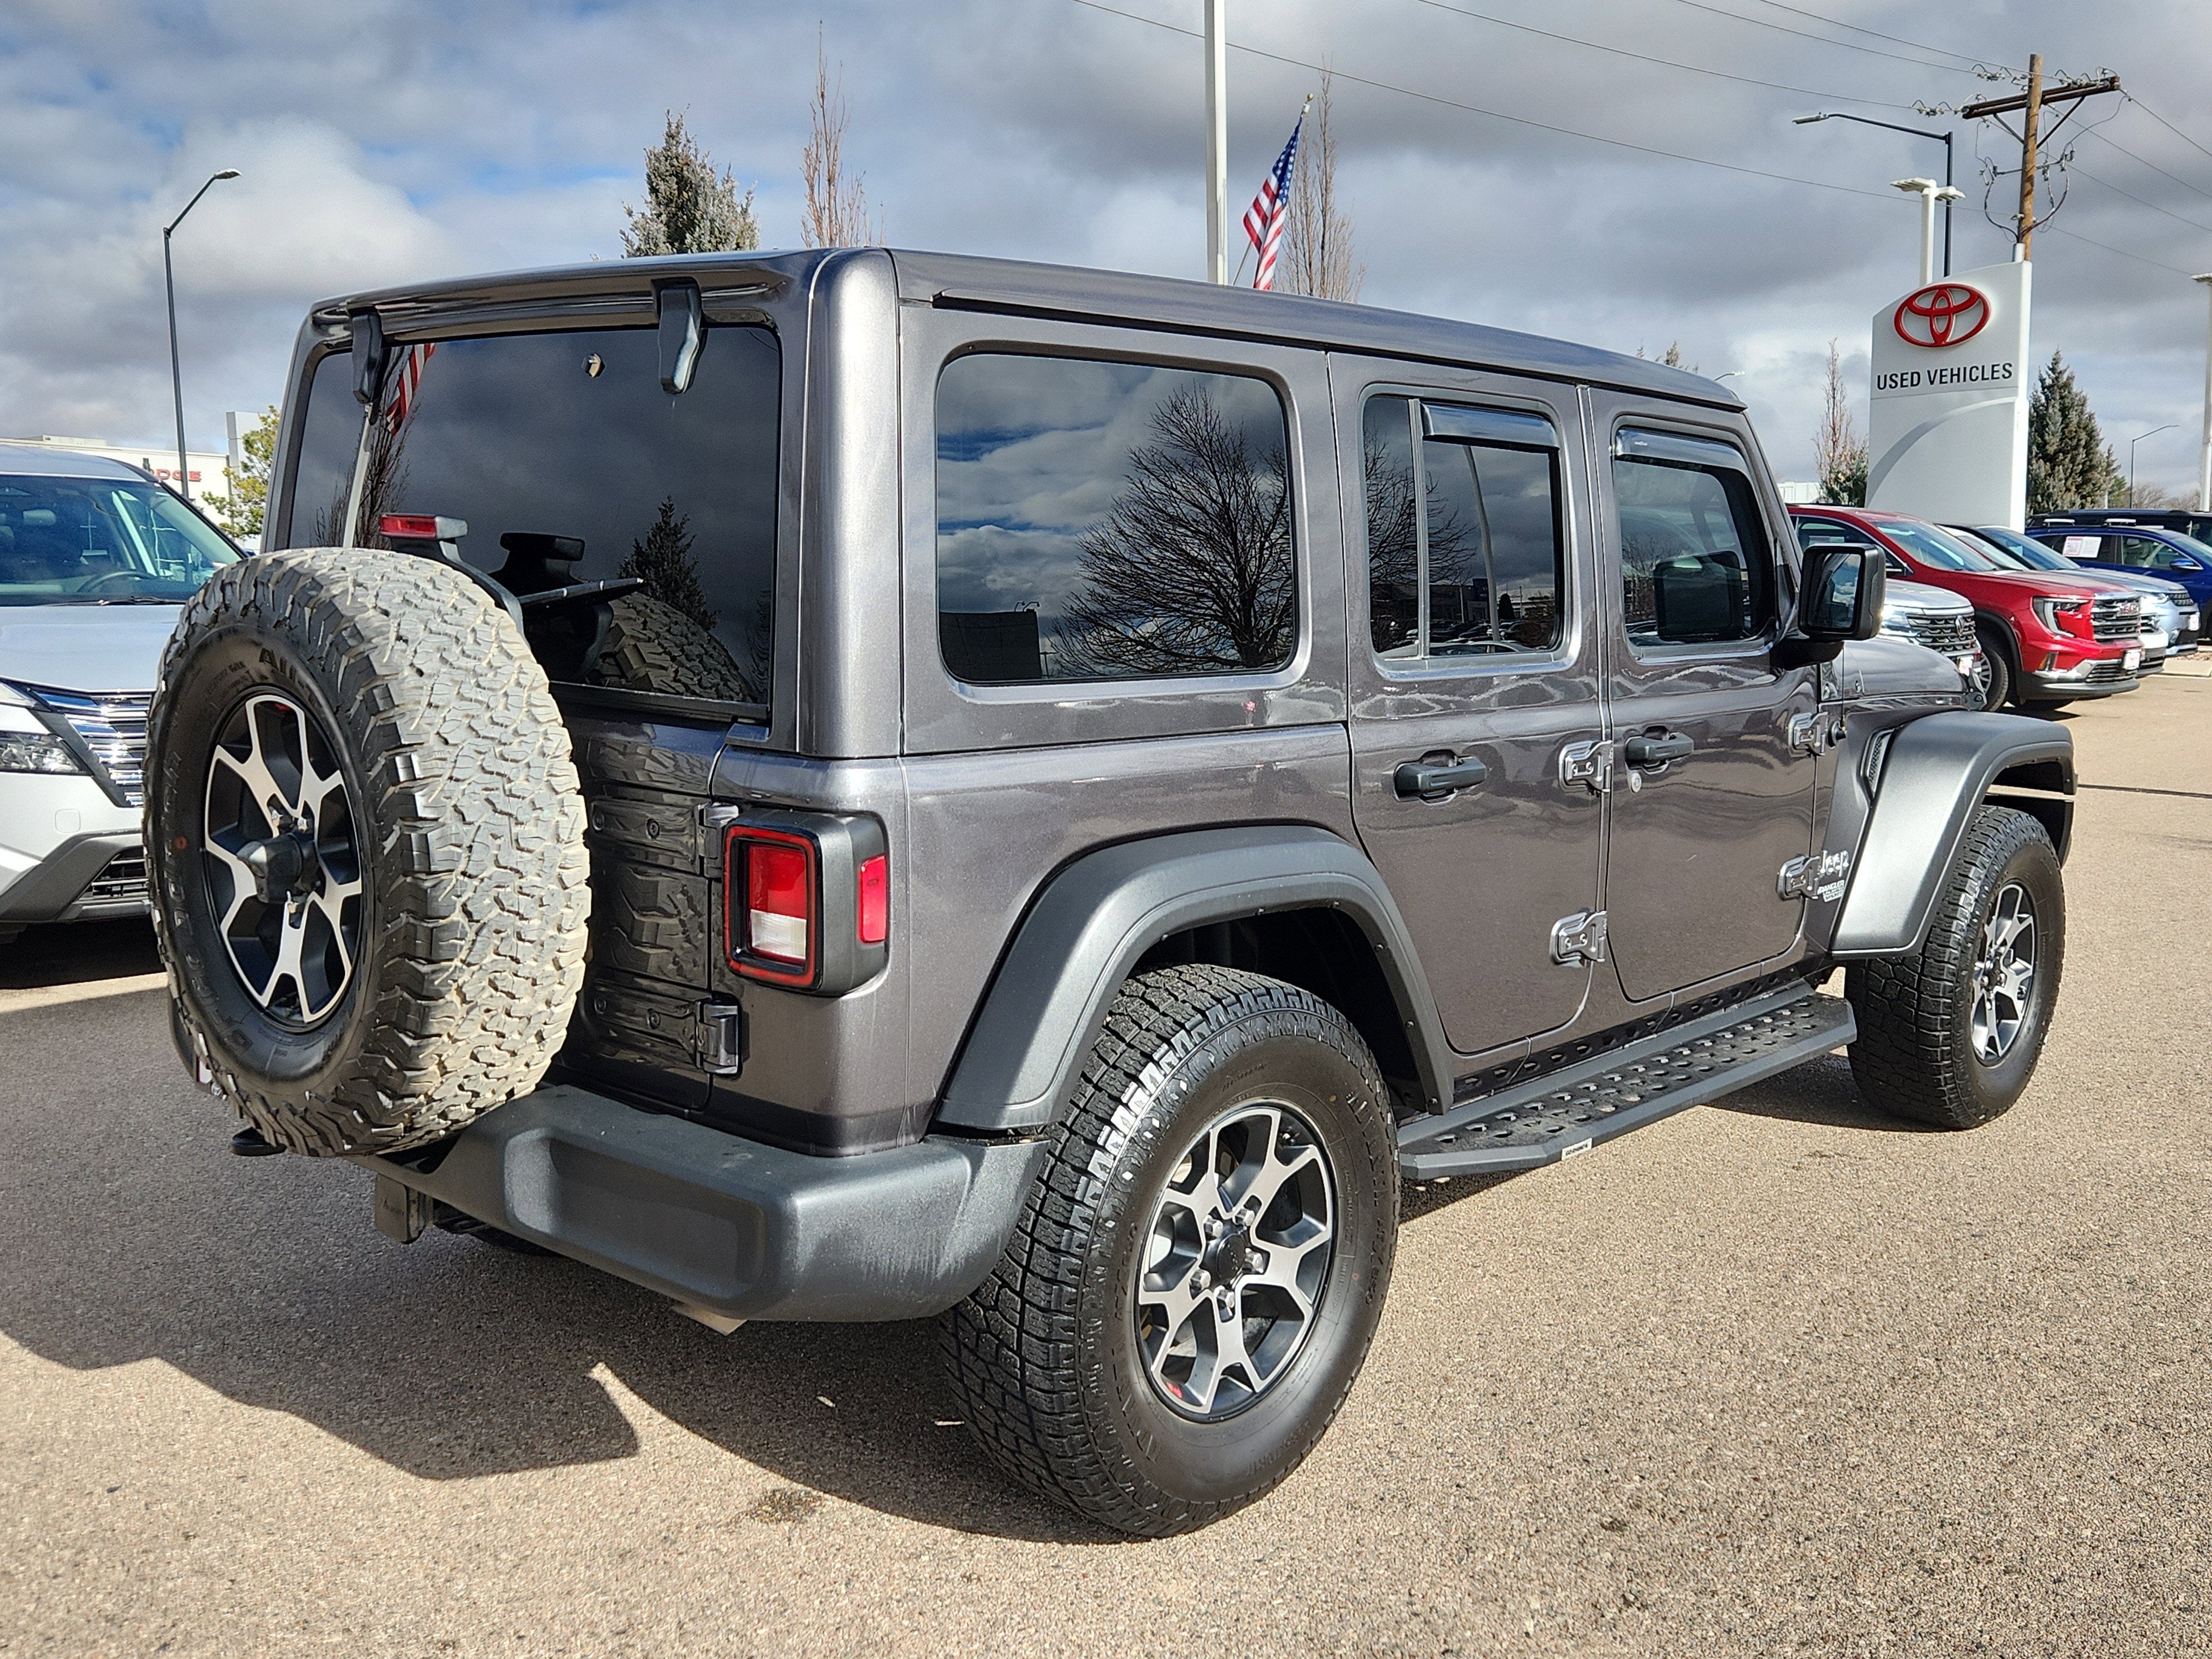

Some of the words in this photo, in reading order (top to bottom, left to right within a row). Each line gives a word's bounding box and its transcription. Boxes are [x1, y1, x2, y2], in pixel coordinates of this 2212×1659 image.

[1876, 370, 1921, 391] USED
[1927, 363, 2013, 385] VEHICLES
[149, 468, 201, 482] DGE
[1816, 850, 1849, 878] Jeep
